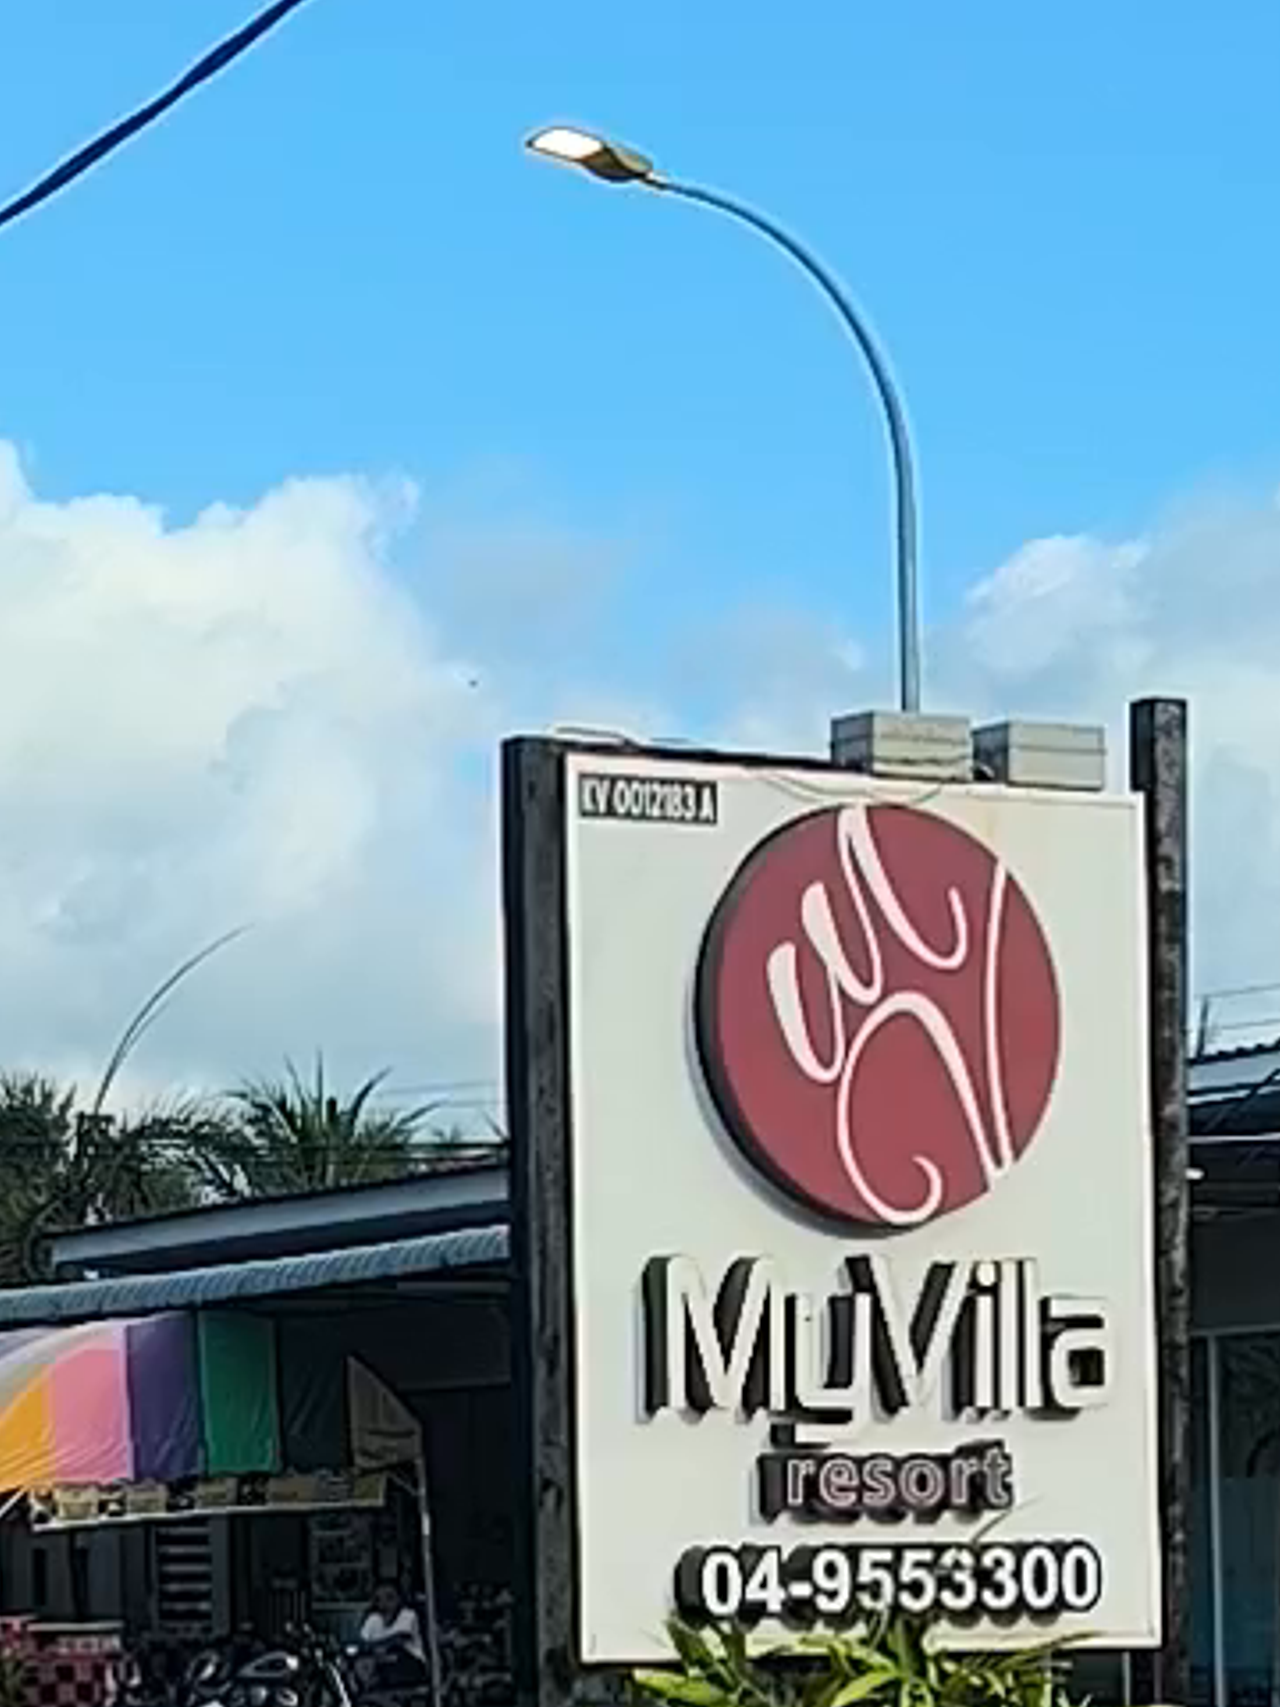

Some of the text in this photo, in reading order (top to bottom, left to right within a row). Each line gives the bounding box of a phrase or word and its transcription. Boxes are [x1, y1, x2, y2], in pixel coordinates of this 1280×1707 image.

[698, 785, 715, 822] A
[652, 1254, 1116, 1445] MyVilla
[786, 1443, 1014, 1507] resort
[700, 1543, 1104, 1617] 04-9553300
